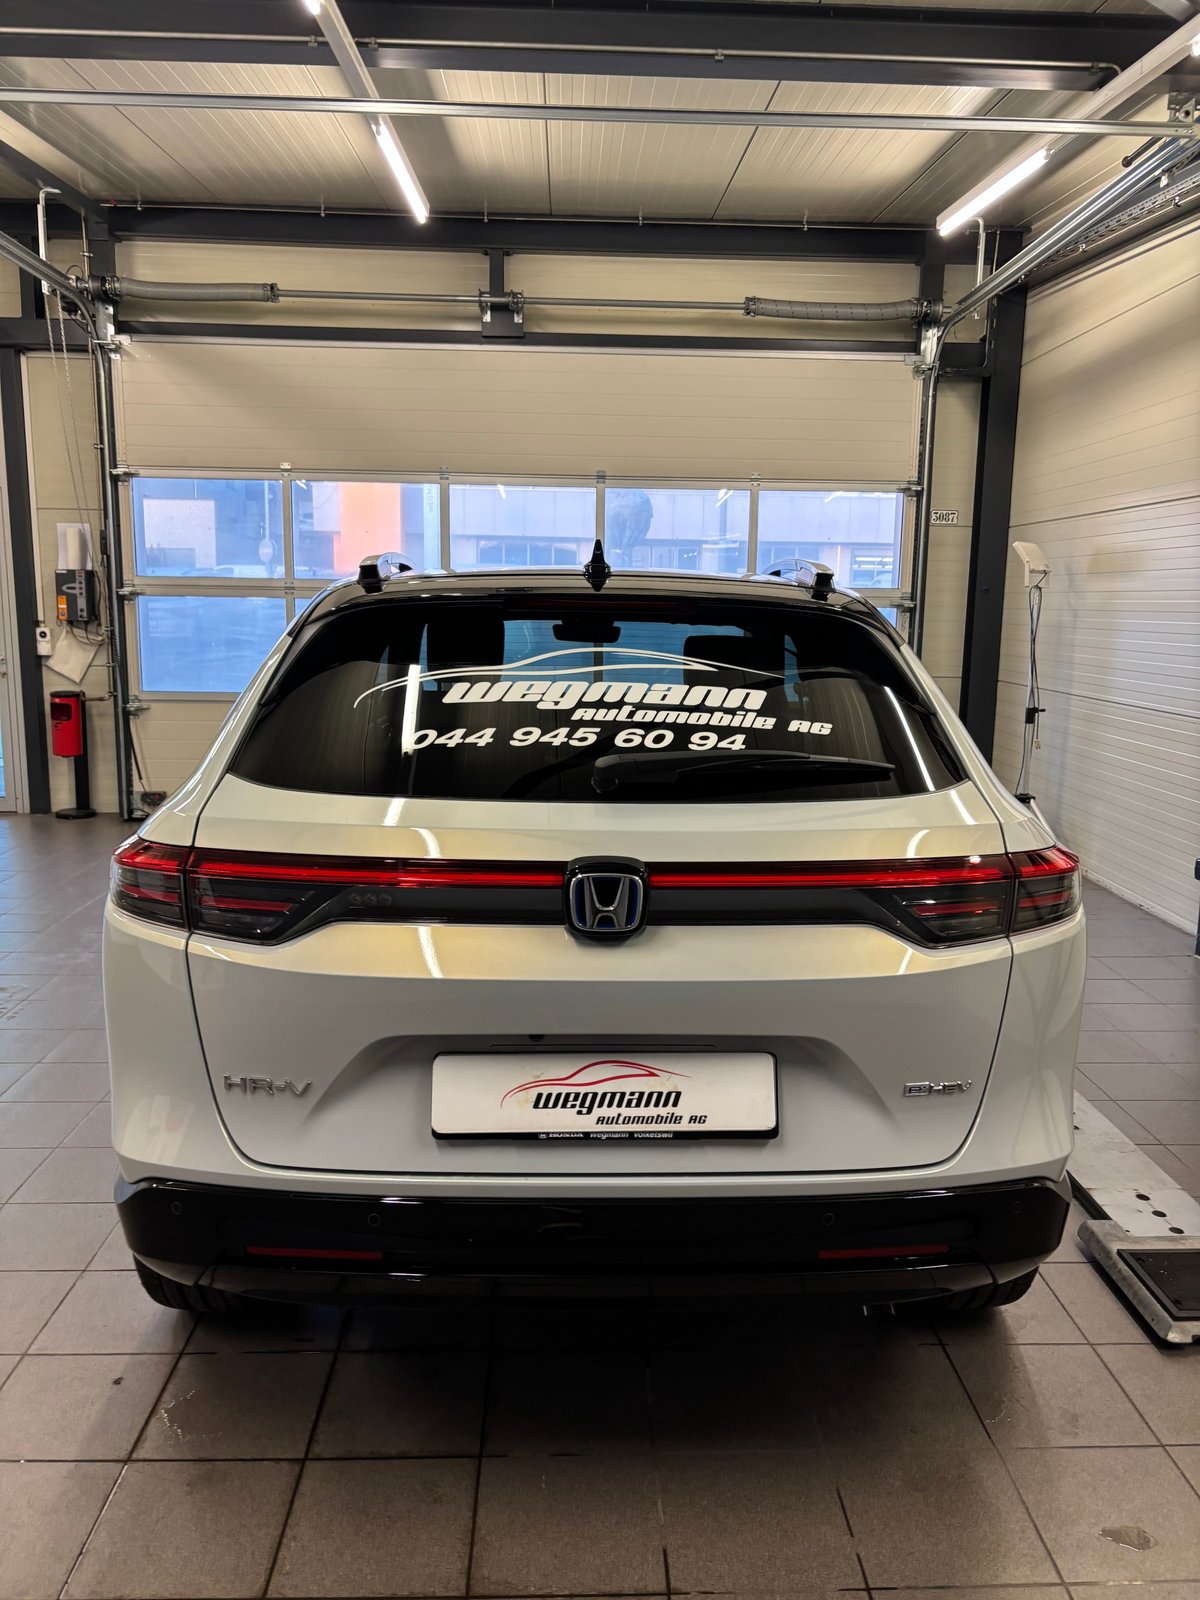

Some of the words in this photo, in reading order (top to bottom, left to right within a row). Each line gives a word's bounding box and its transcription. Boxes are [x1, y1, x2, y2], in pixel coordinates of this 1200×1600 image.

[932, 511, 957, 523] 3087
[442, 680, 767, 710] wegmann
[411, 727, 497, 750] 044
[509, 726, 601, 747] 945
[614, 728, 675, 749] 60
[687, 731, 747, 751] 94
[787, 719, 833, 735] AG
[223, 1073, 312, 1097] HR-V
[532, 1090, 682, 1116] wegmann
[688, 1114, 708, 1125] AG
